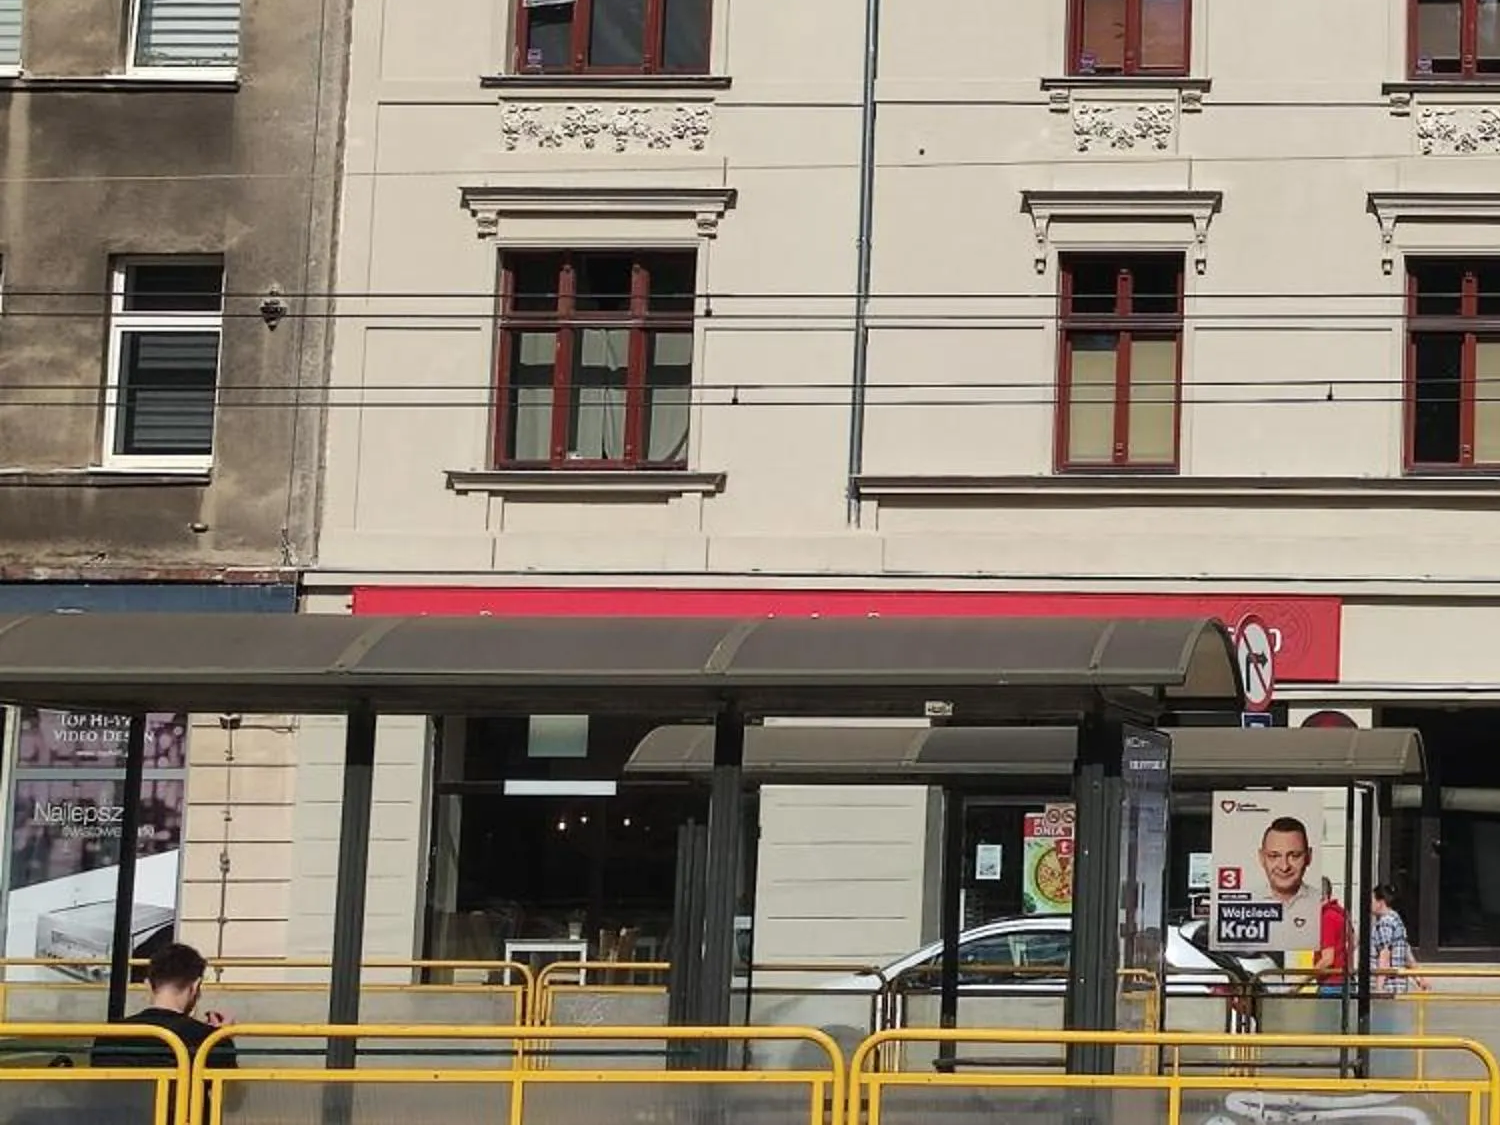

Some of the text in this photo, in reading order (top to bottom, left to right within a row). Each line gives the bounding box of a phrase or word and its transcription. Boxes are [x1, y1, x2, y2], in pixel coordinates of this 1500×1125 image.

[53, 730, 154, 743] VIDEO DESN
[34, 802, 125, 825] Najlepsz
[1222, 870, 1238, 888] 3
[1221, 906, 1279, 919] Wojciech
[1221, 921, 1265, 938] Król
